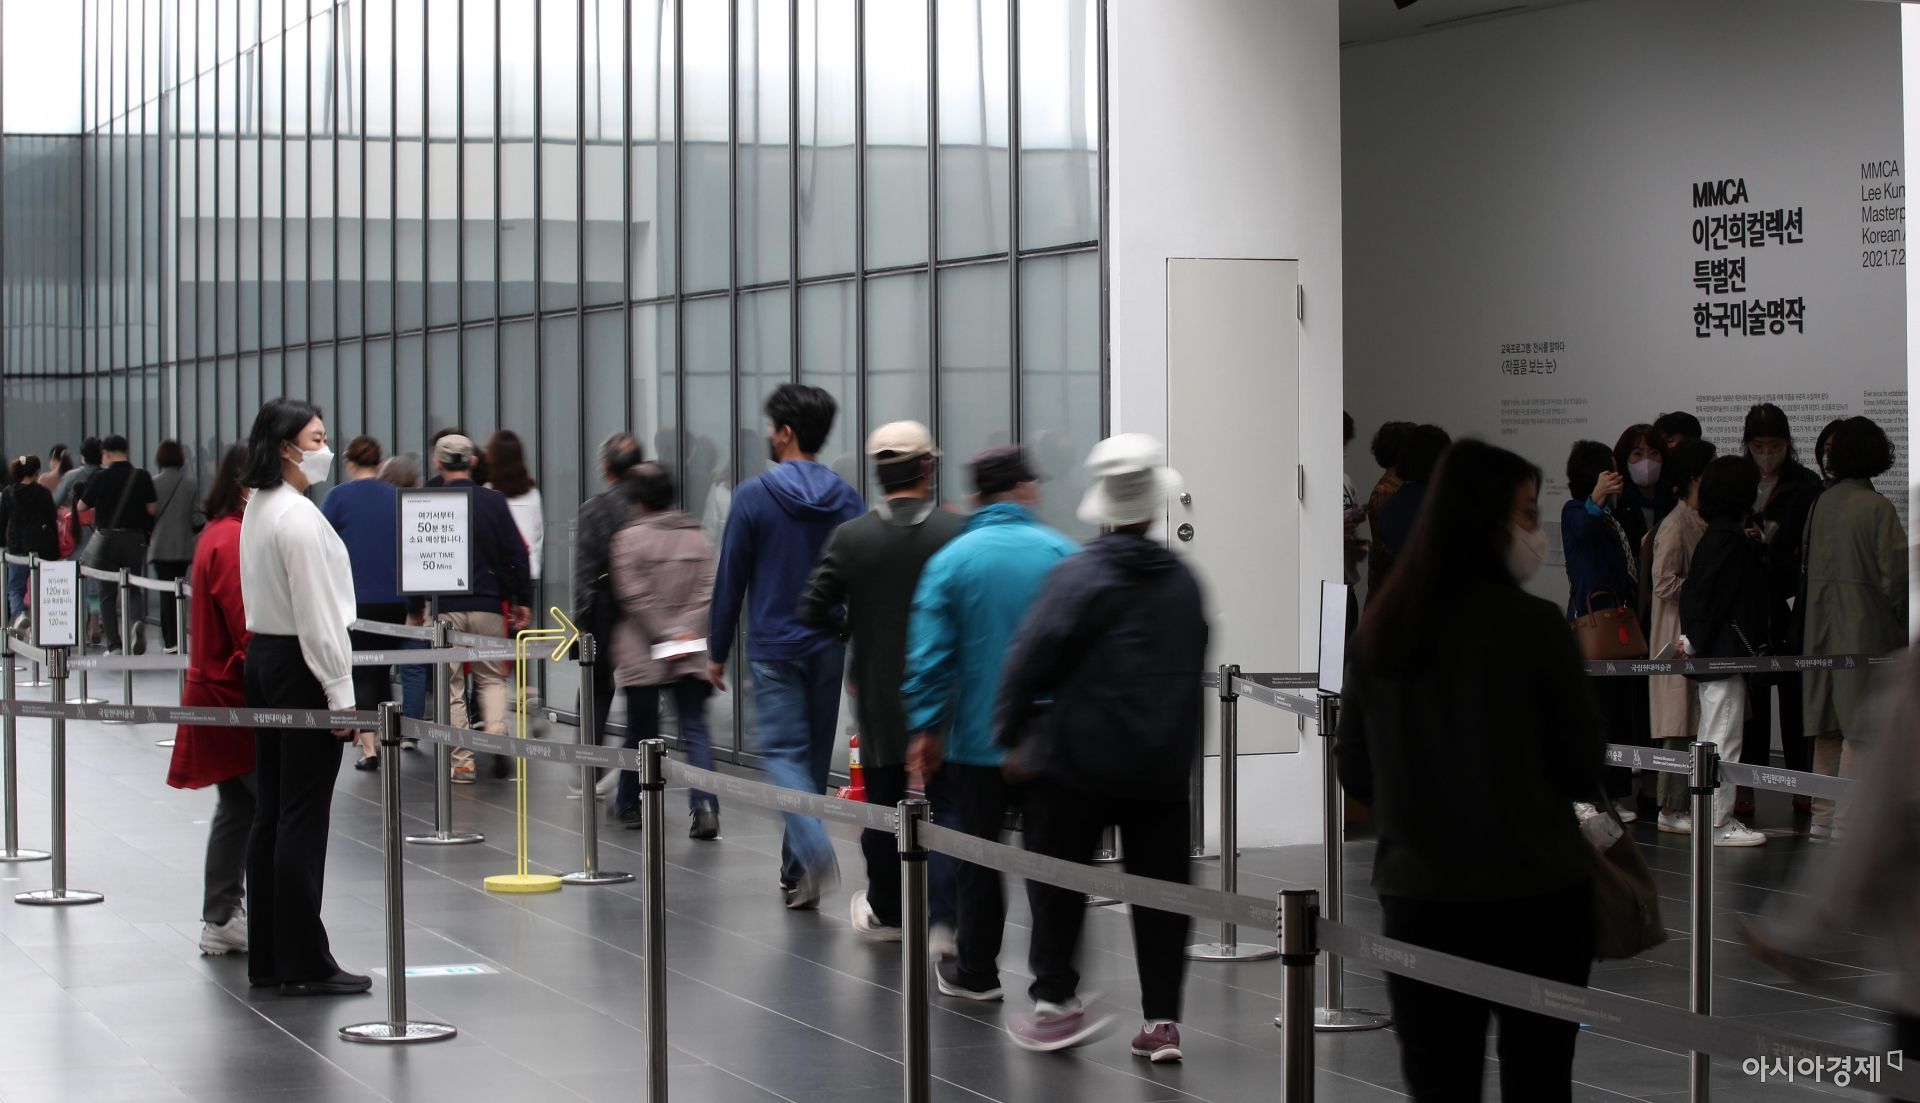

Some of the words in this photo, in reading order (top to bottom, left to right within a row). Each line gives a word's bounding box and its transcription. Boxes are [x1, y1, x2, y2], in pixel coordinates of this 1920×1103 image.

[1861, 160, 1899, 180] MMCA
[1693, 178, 1748, 208] MMCA
[1861, 185, 1881, 201] Lee
[1692, 207, 1803, 251] 이건희컬렉션
[1862, 228, 1900, 244] Korean
[1693, 256, 1746, 295] 특별전
[1693, 297, 1805, 338] 한국미술명작
[1529, 359, 1544, 374] 보는
[418, 511, 454, 520] 여기서부터
[417, 522, 439, 533] 50분
[441, 524, 455, 533] 정도
[422, 561, 435, 570] 50
